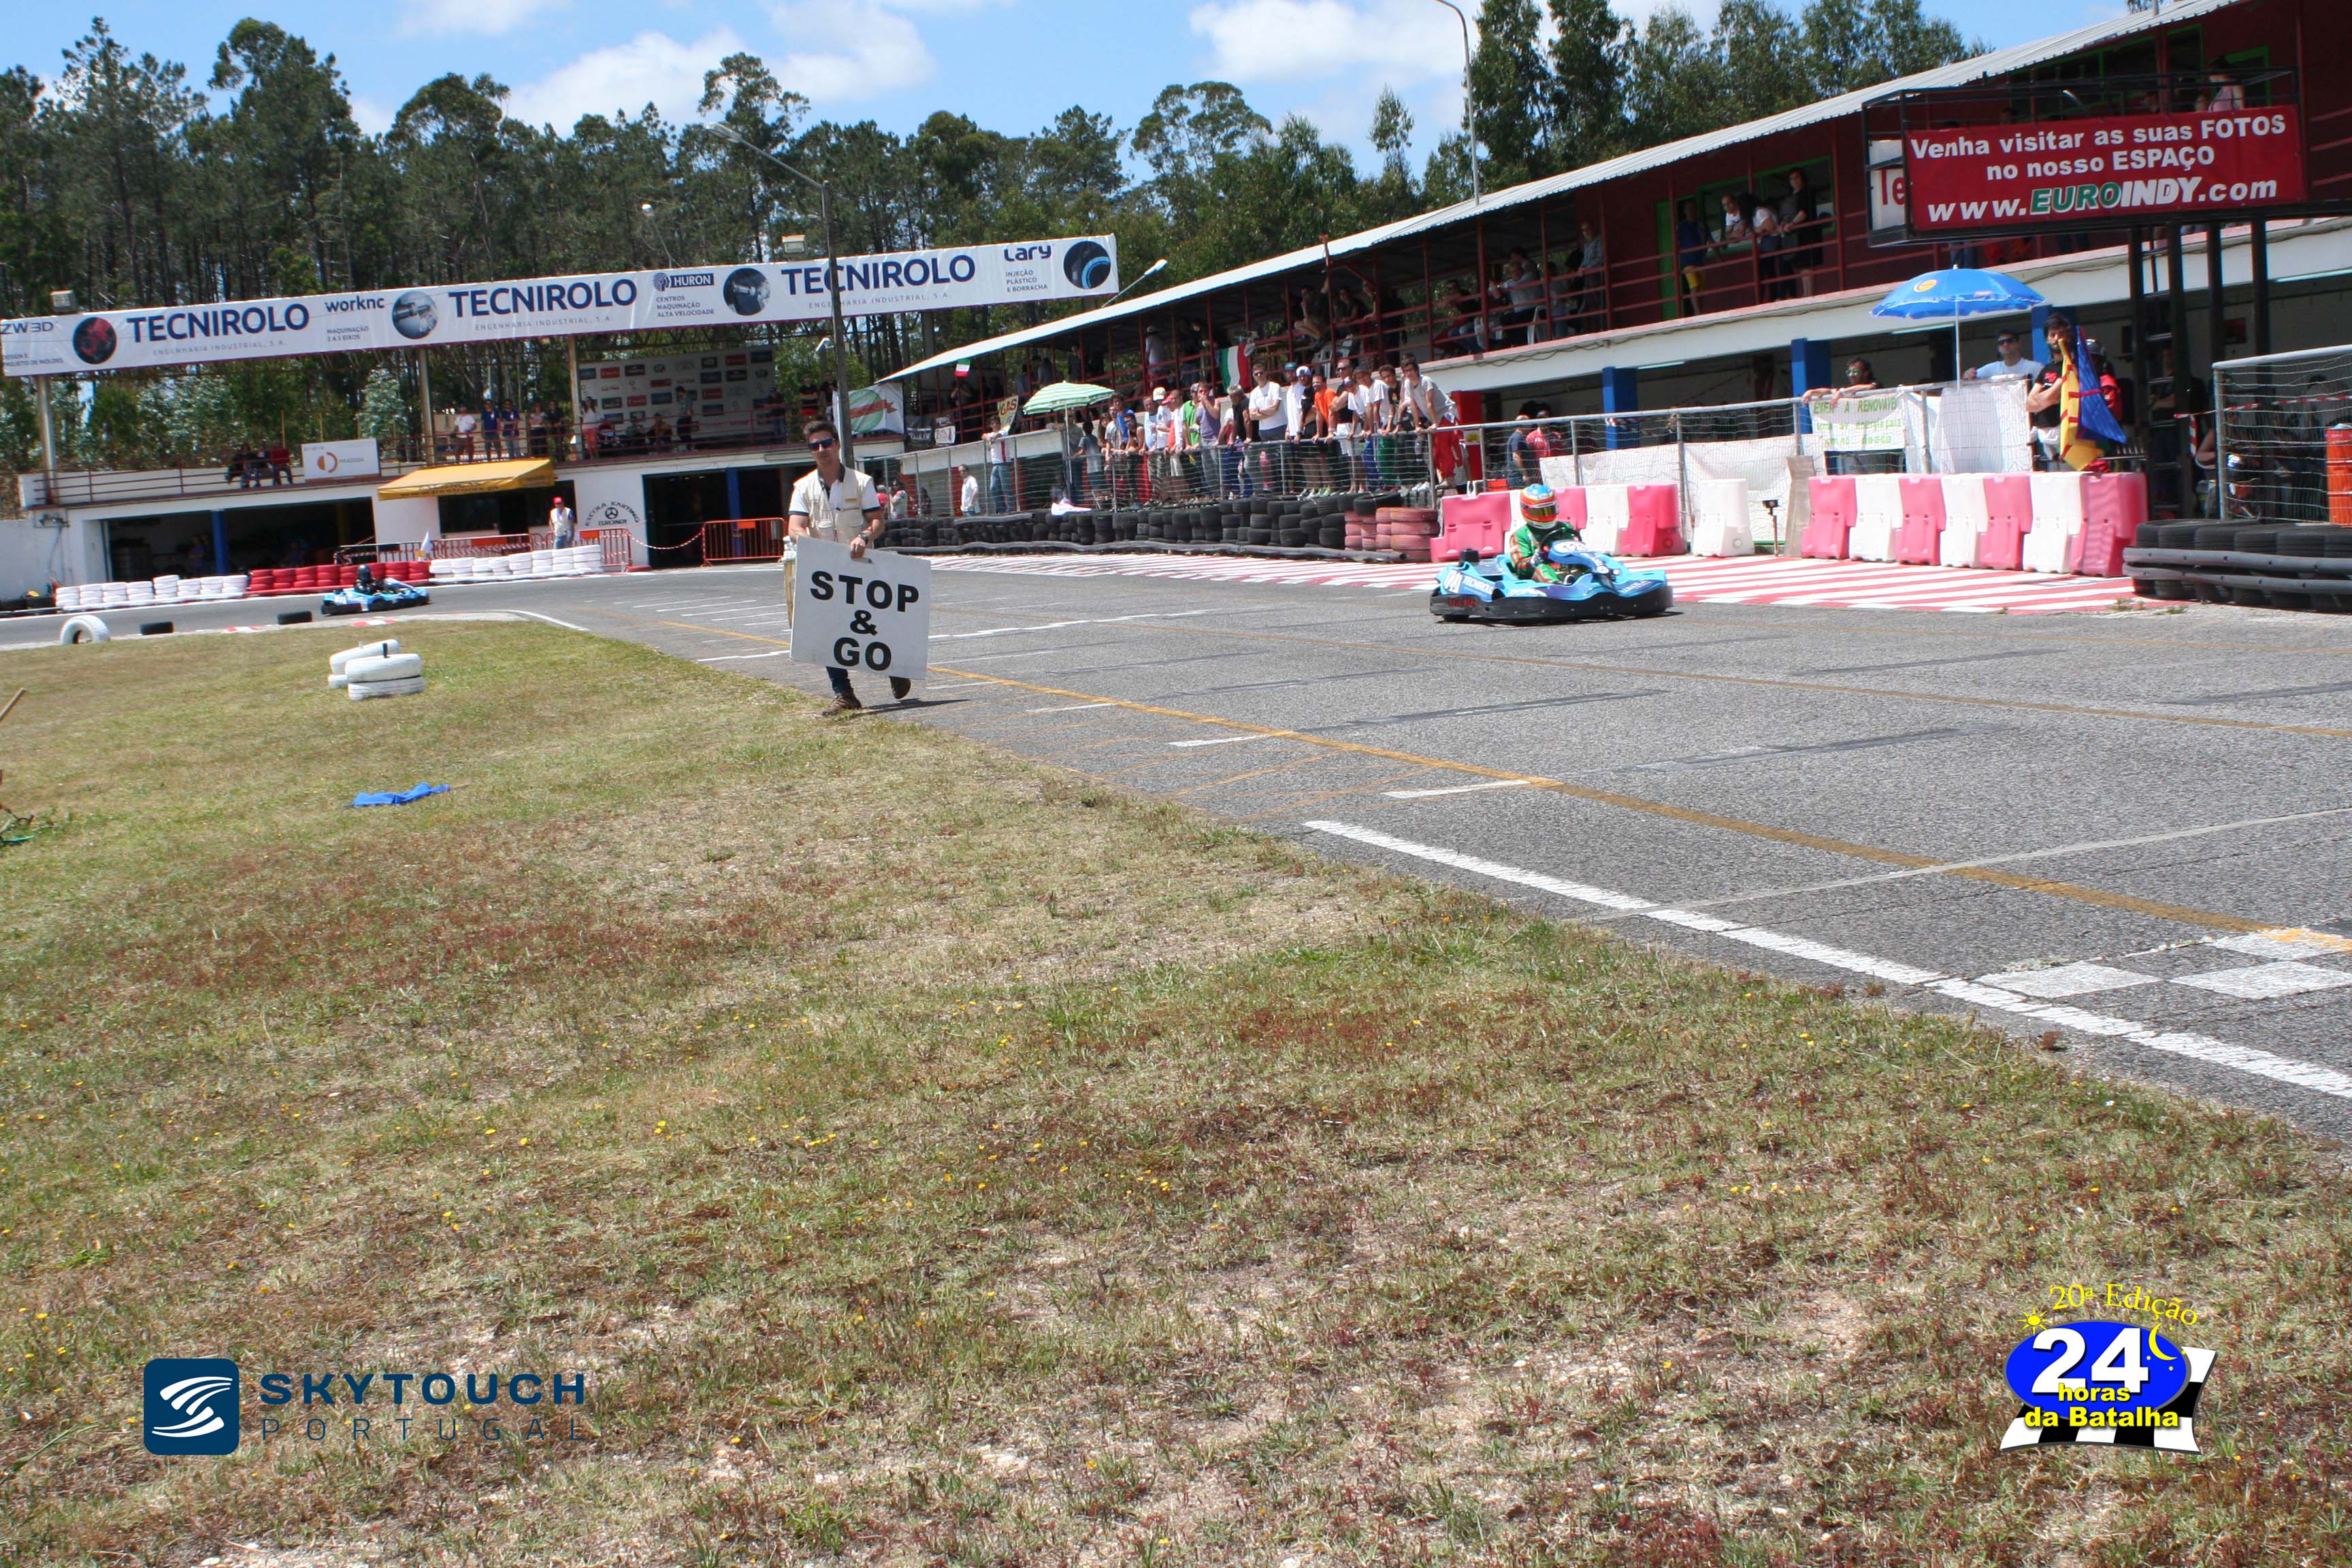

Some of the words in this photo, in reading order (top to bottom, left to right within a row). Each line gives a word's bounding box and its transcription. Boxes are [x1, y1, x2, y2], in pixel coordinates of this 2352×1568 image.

[1910, 136, 1990, 159] Venha
[1999, 131, 2085, 153] visitar
[2094, 129, 2124, 146] as
[2133, 125, 2193, 143] suas
[2201, 114, 2286, 139] FOTOS
[1987, 164, 2019, 180] no
[2027, 157, 2104, 178] nosso
[2112, 146, 2215, 171] ESPAÇO
[1927, 176, 2277, 222] www.EUROINDY.com
[674, 275, 711, 286] HURON
[781, 255, 975, 295] TECNIROLO
[1006, 269, 1034, 277] INJEÇÃO
[325, 295, 385, 312] worknc
[448, 278, 637, 318] TECNIROLO
[808, 299, 867, 308] ENGEHARIA
[126, 304, 310, 343] TECNIROLO
[810, 570, 919, 612] STOP
[849, 610, 878, 636] &
[834, 637, 892, 671] GO
